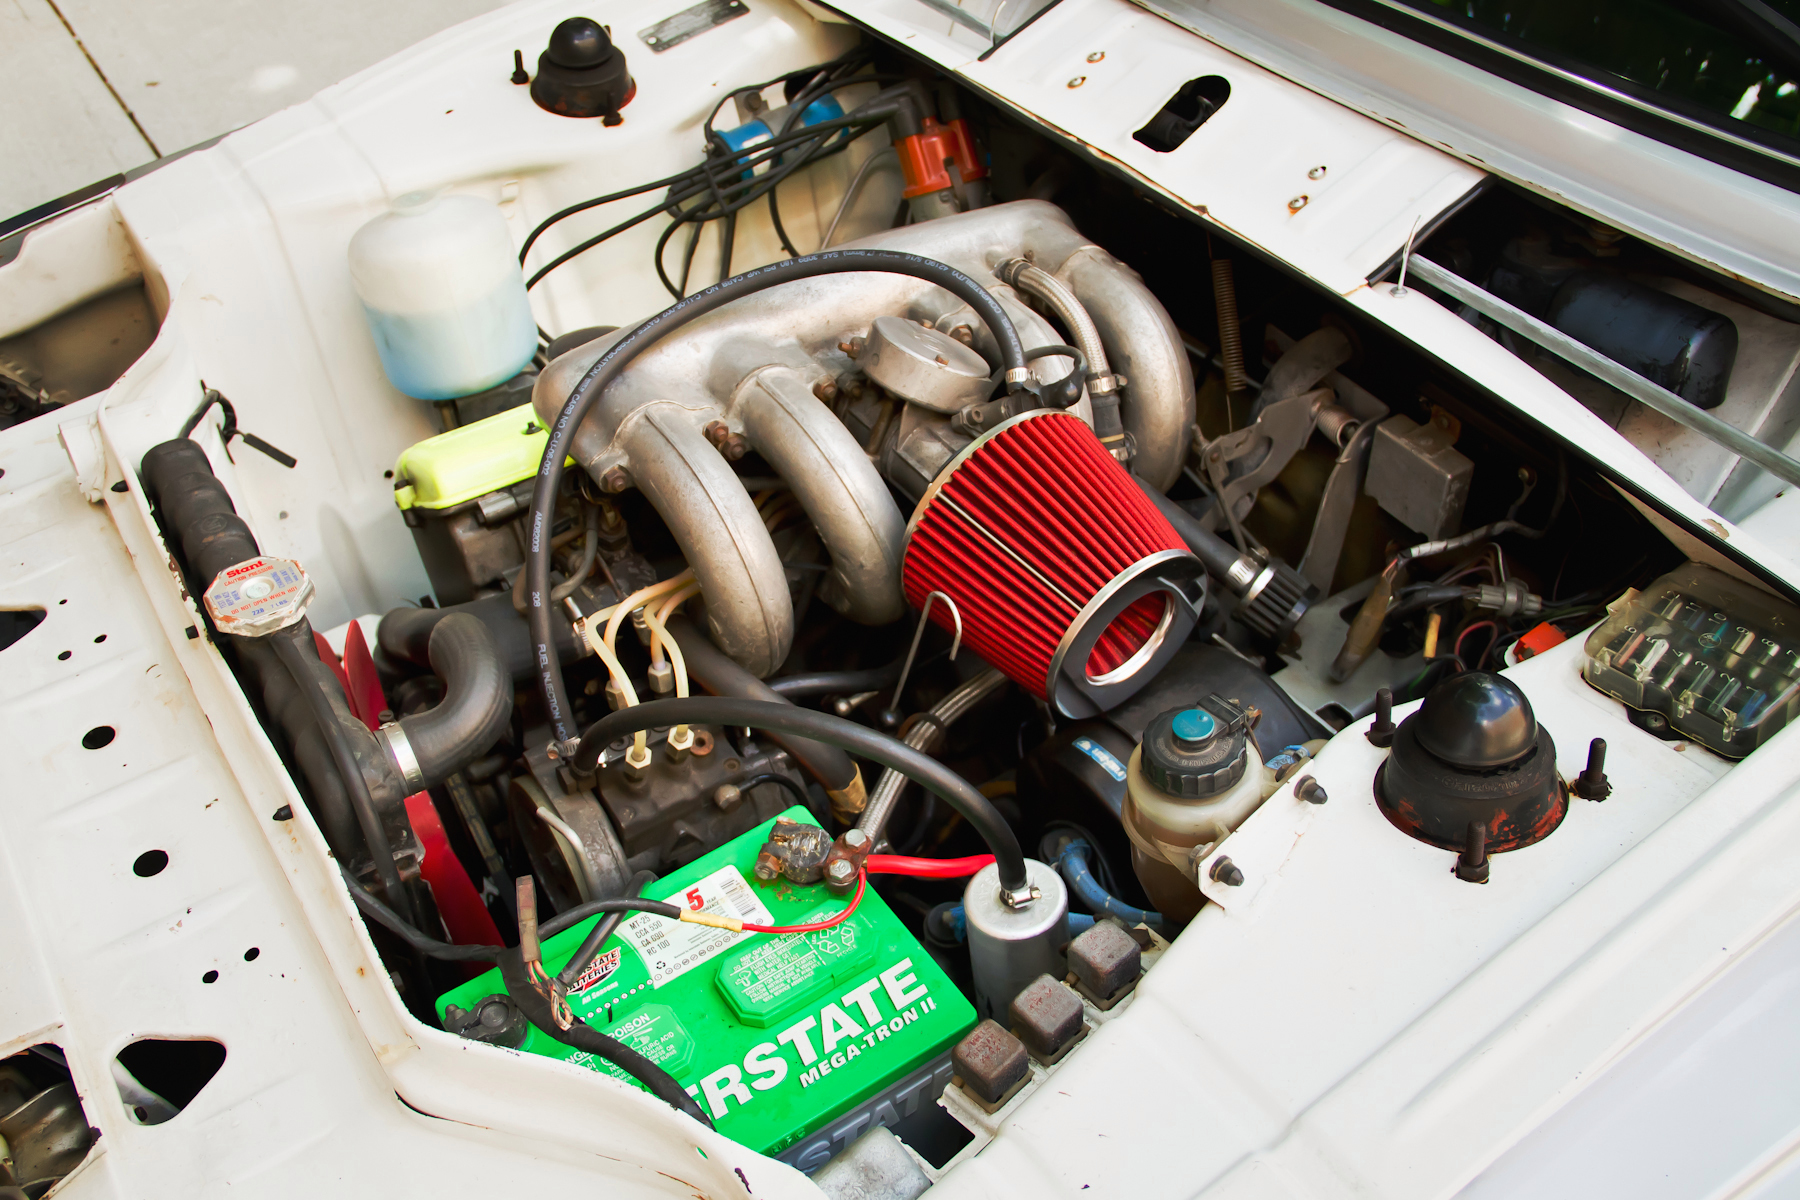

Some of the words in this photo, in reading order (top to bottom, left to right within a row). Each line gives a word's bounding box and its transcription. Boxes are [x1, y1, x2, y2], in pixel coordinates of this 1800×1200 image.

[564, 394, 580, 414] CARB
[224, 576, 246, 586] CAUTION
[248, 565, 274, 577] PRESSURE
[226, 560, 266, 578] Stant
[241, 602, 252, 611] NOT
[253, 598, 268, 606] OPEN
[269, 591, 286, 600] WHEN
[536, 643, 549, 668] FUEL
[542, 671, 560, 719] INJECTION
[556, 722, 567, 741] HOS
[686, 888, 704, 911] 5
[629, 914, 650, 930] MT-25
[634, 927, 649, 939] CCA
[648, 919, 662, 931] 550
[640, 937, 651, 947] CA
[646, 945, 657, 956] RC
[657, 938, 670, 950] 100
[660, 1032, 674, 1043] ACID
[800, 1006, 920, 1088] MEGA-TRON
